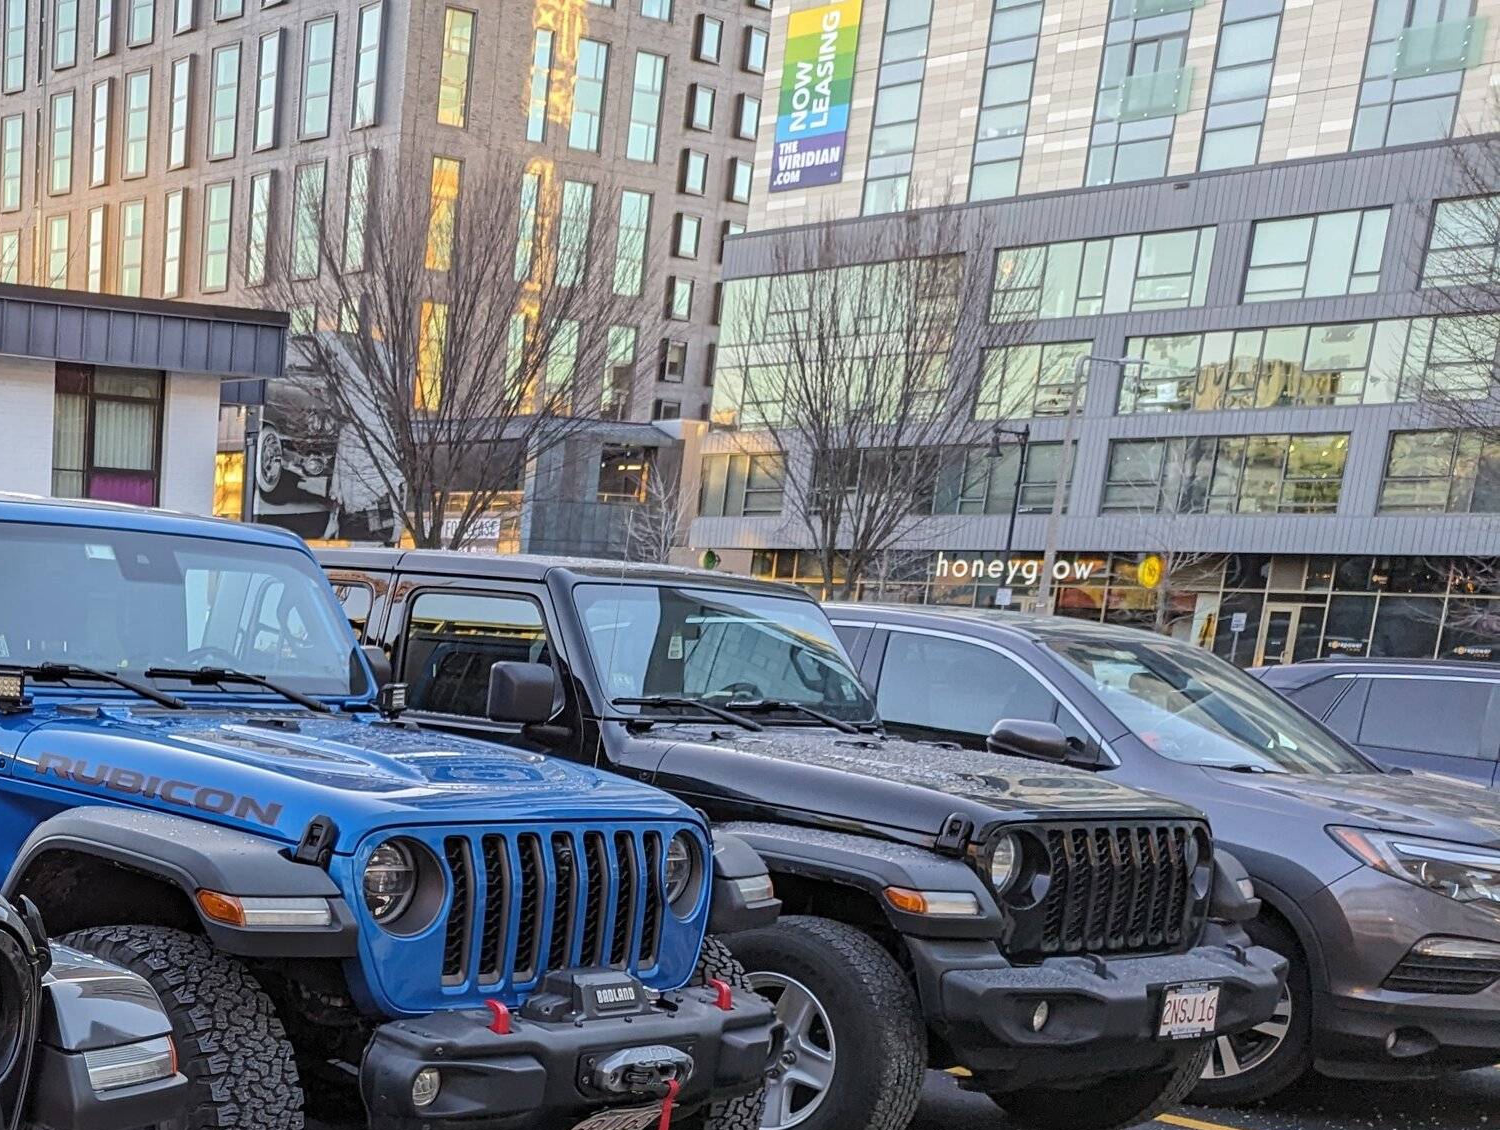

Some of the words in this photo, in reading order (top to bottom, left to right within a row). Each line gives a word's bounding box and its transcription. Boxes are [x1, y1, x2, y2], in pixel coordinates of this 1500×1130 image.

[810, 10, 841, 128] LEASING
[789, 62, 813, 132] NOW
[778, 146, 841, 172] VIRIDIAN
[779, 140, 799, 154] THE
[773, 170, 800, 186] .COM
[935, 551, 1094, 585] honeygow
[35, 751, 283, 827] RUBICON
[596, 987, 635, 1004] BADLAND
